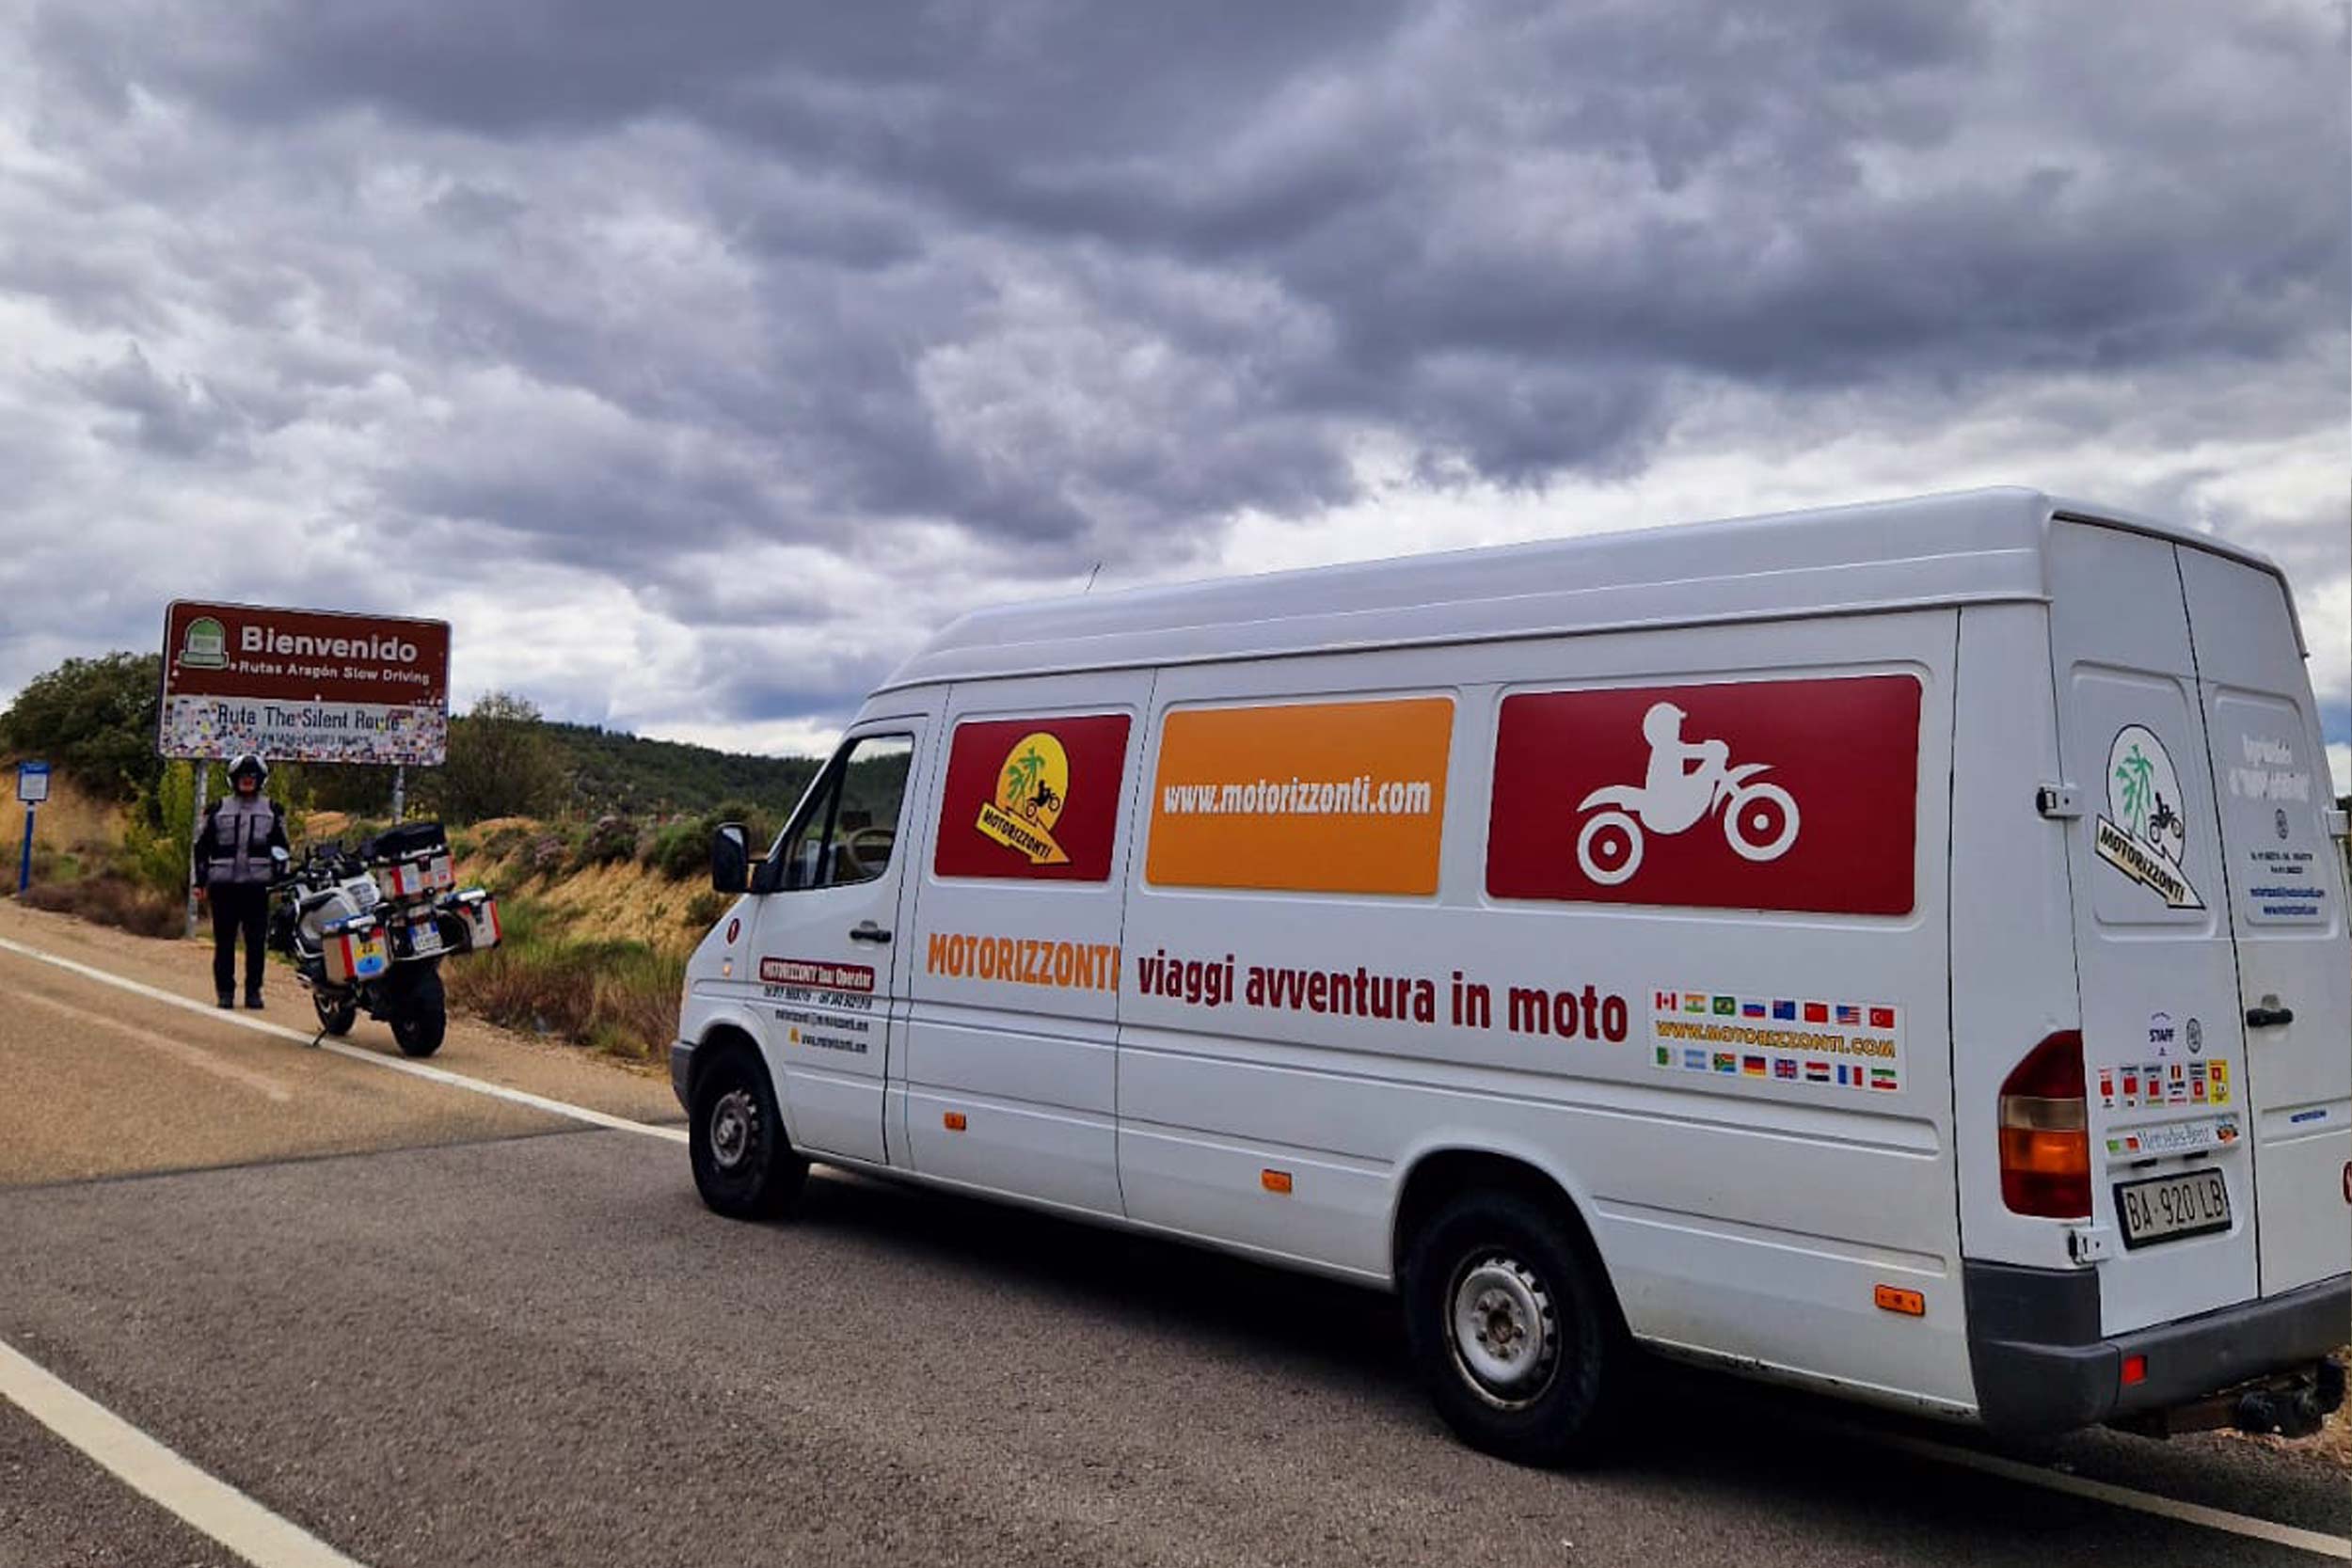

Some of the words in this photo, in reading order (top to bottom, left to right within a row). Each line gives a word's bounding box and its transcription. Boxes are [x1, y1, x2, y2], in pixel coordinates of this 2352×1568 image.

[241, 625, 419, 663] Bienvenido
[239, 660, 282, 675] Rutas
[287, 662, 338, 679] Aragón
[343, 667, 378, 680] Slow
[383, 669, 430, 686] Driving
[217, 705, 257, 725] Ruta
[263, 706, 295, 727] The
[302, 707, 348, 729] Silent
[1163, 775, 1432, 816] www.motorizzonti.com
[982, 809, 1052, 860] MOTORIZZONTI
[2099, 825, 2186, 903] MOTORIZZONTI
[927, 933, 1120, 991] MOTORIZZONTI
[1137, 949, 1234, 1009] viaggi
[1246, 965, 1436, 1023] avventura
[1451, 971, 1491, 1029] in
[1508, 985, 1629, 1043] moto
[1655, 1020, 1897, 1059] WWW.MOTORIZZONTI.COM
